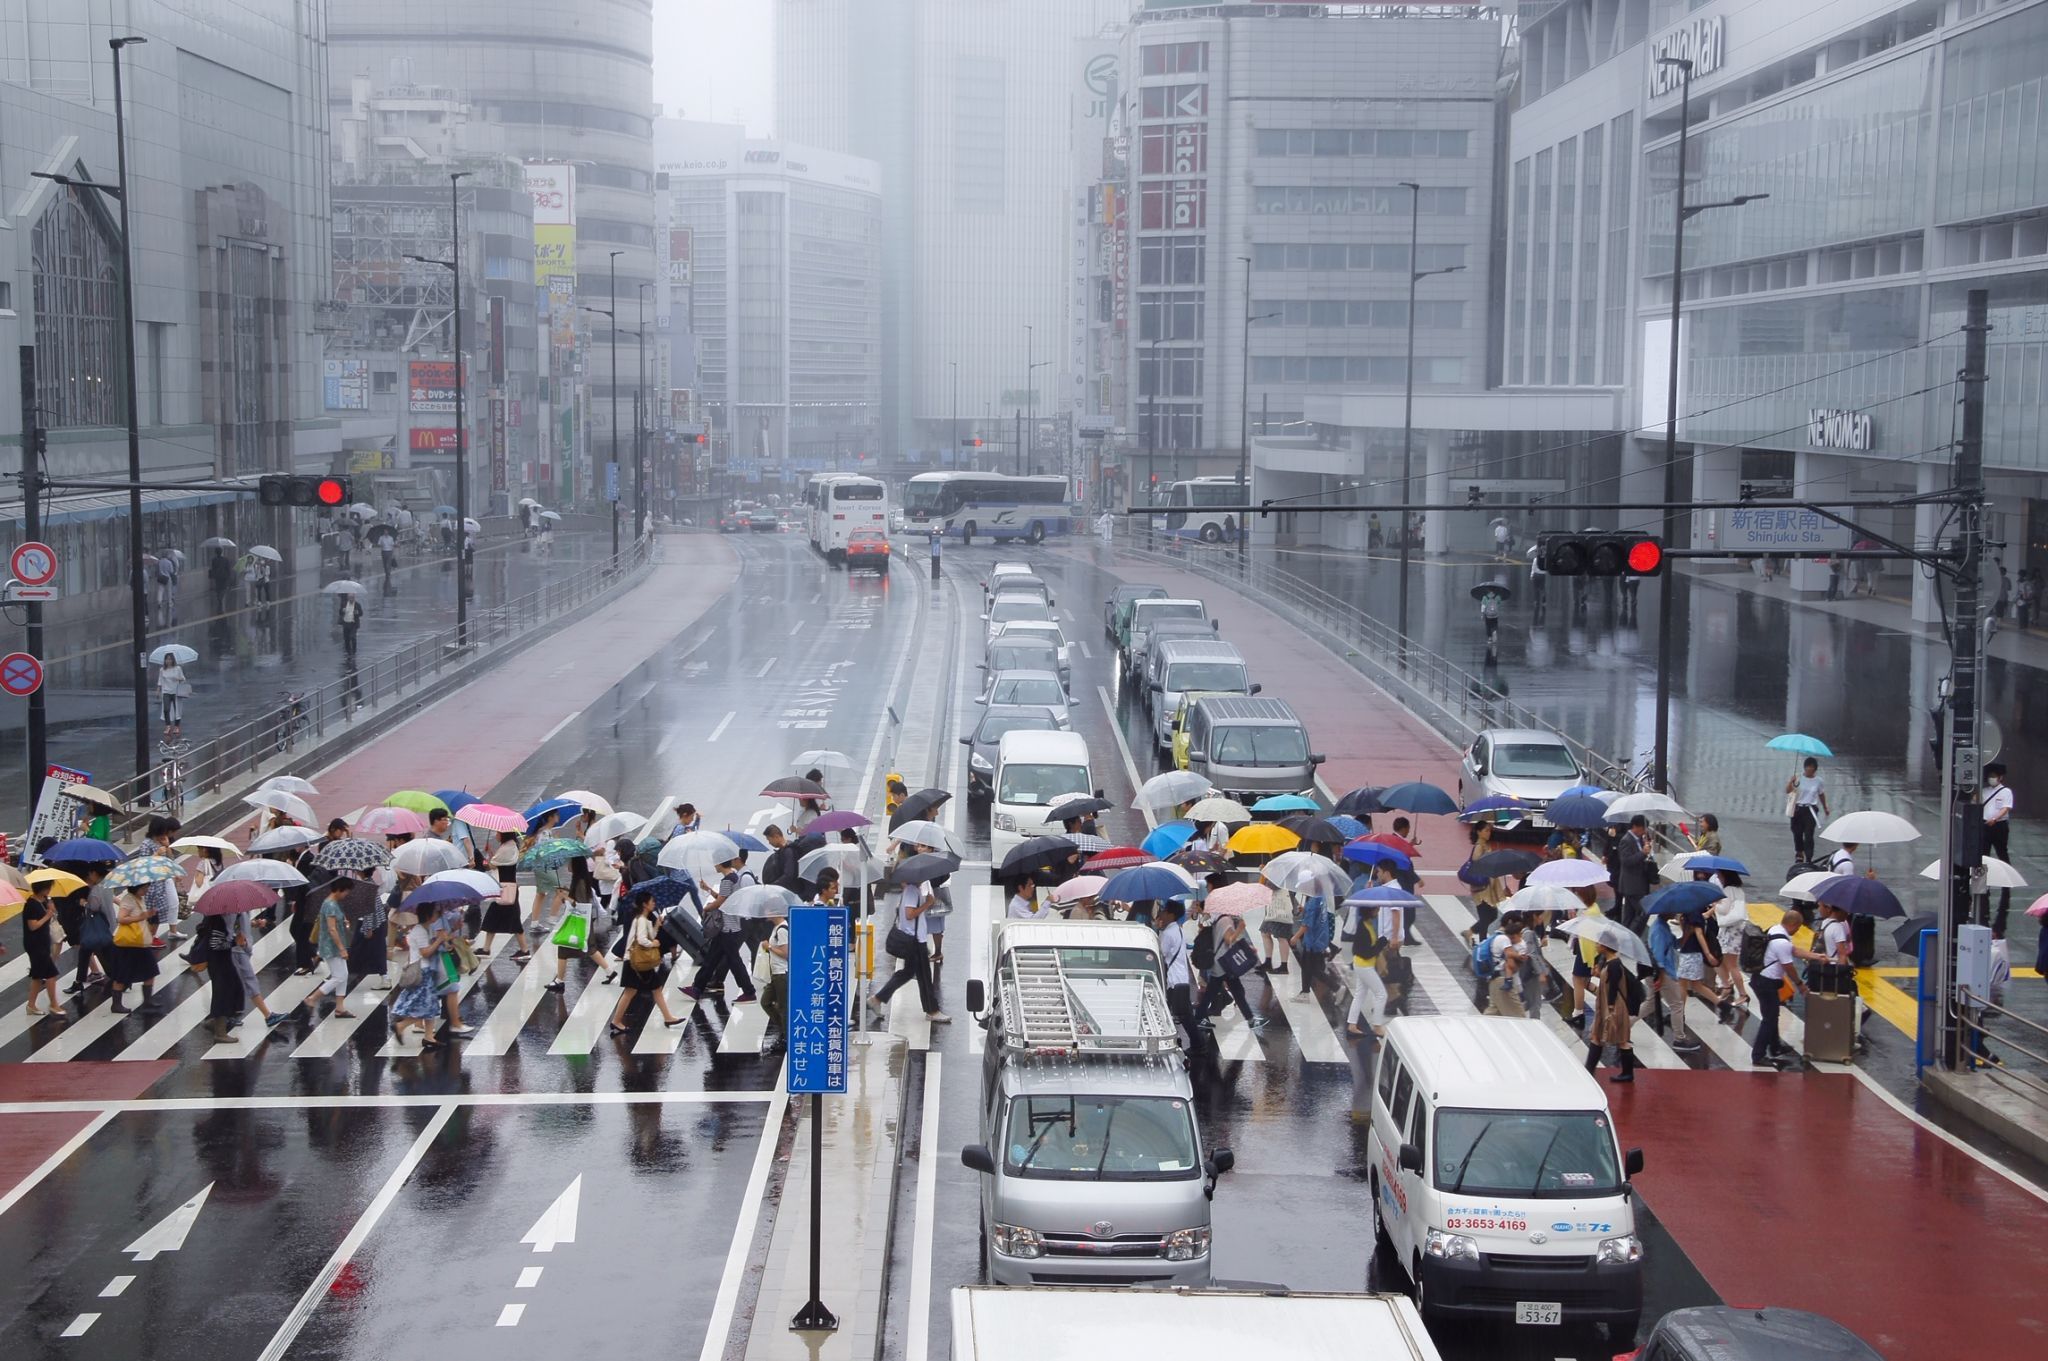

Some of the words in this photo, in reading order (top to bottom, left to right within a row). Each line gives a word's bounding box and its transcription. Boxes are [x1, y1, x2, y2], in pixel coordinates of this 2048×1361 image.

[659, 159, 727, 171] www.keio.co.jp
[411, 369, 461, 378] BOOK-O
[1808, 408, 1871, 450] NEWoMan
[562, 441, 572, 469] レイク
[1731, 508, 1841, 530] 新宿駅南口
[1747, 531, 1798, 544] Shinjuku
[1801, 531, 1824, 543] Sta.
[51, 769, 85, 784] お知らせ
[810, 945, 826, 1054] バスタ新宿へは
[828, 915, 844, 1087] 一般車・貸切バス・大型貨物車は
[793, 1009, 808, 1087] 入れません
[1447, 1218, 1526, 1231] 03-3653-4169
[1588, 1222, 1612, 1233] フキ
[1526, 1311, 1558, 1323] 53-67
